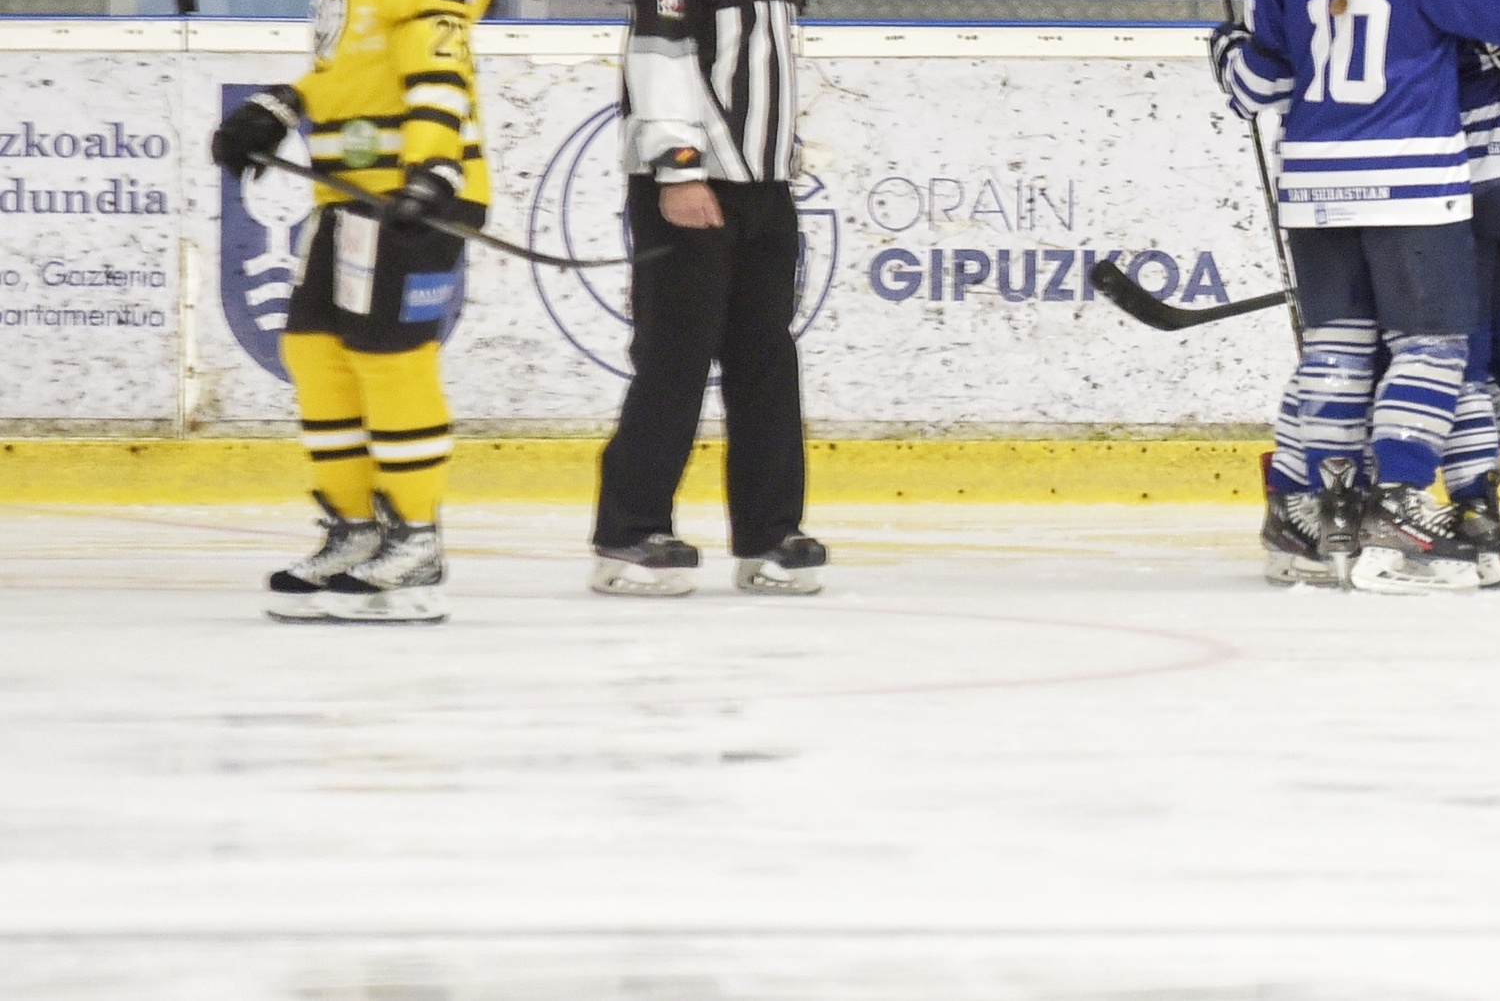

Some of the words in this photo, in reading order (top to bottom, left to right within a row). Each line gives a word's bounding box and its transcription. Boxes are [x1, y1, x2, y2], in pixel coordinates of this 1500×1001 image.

[0, 120, 171, 159] zkoako
[0, 176, 170, 215] dundia
[867, 176, 1075, 232] ORAIN
[869, 247, 1230, 303] GIPUZKOA
